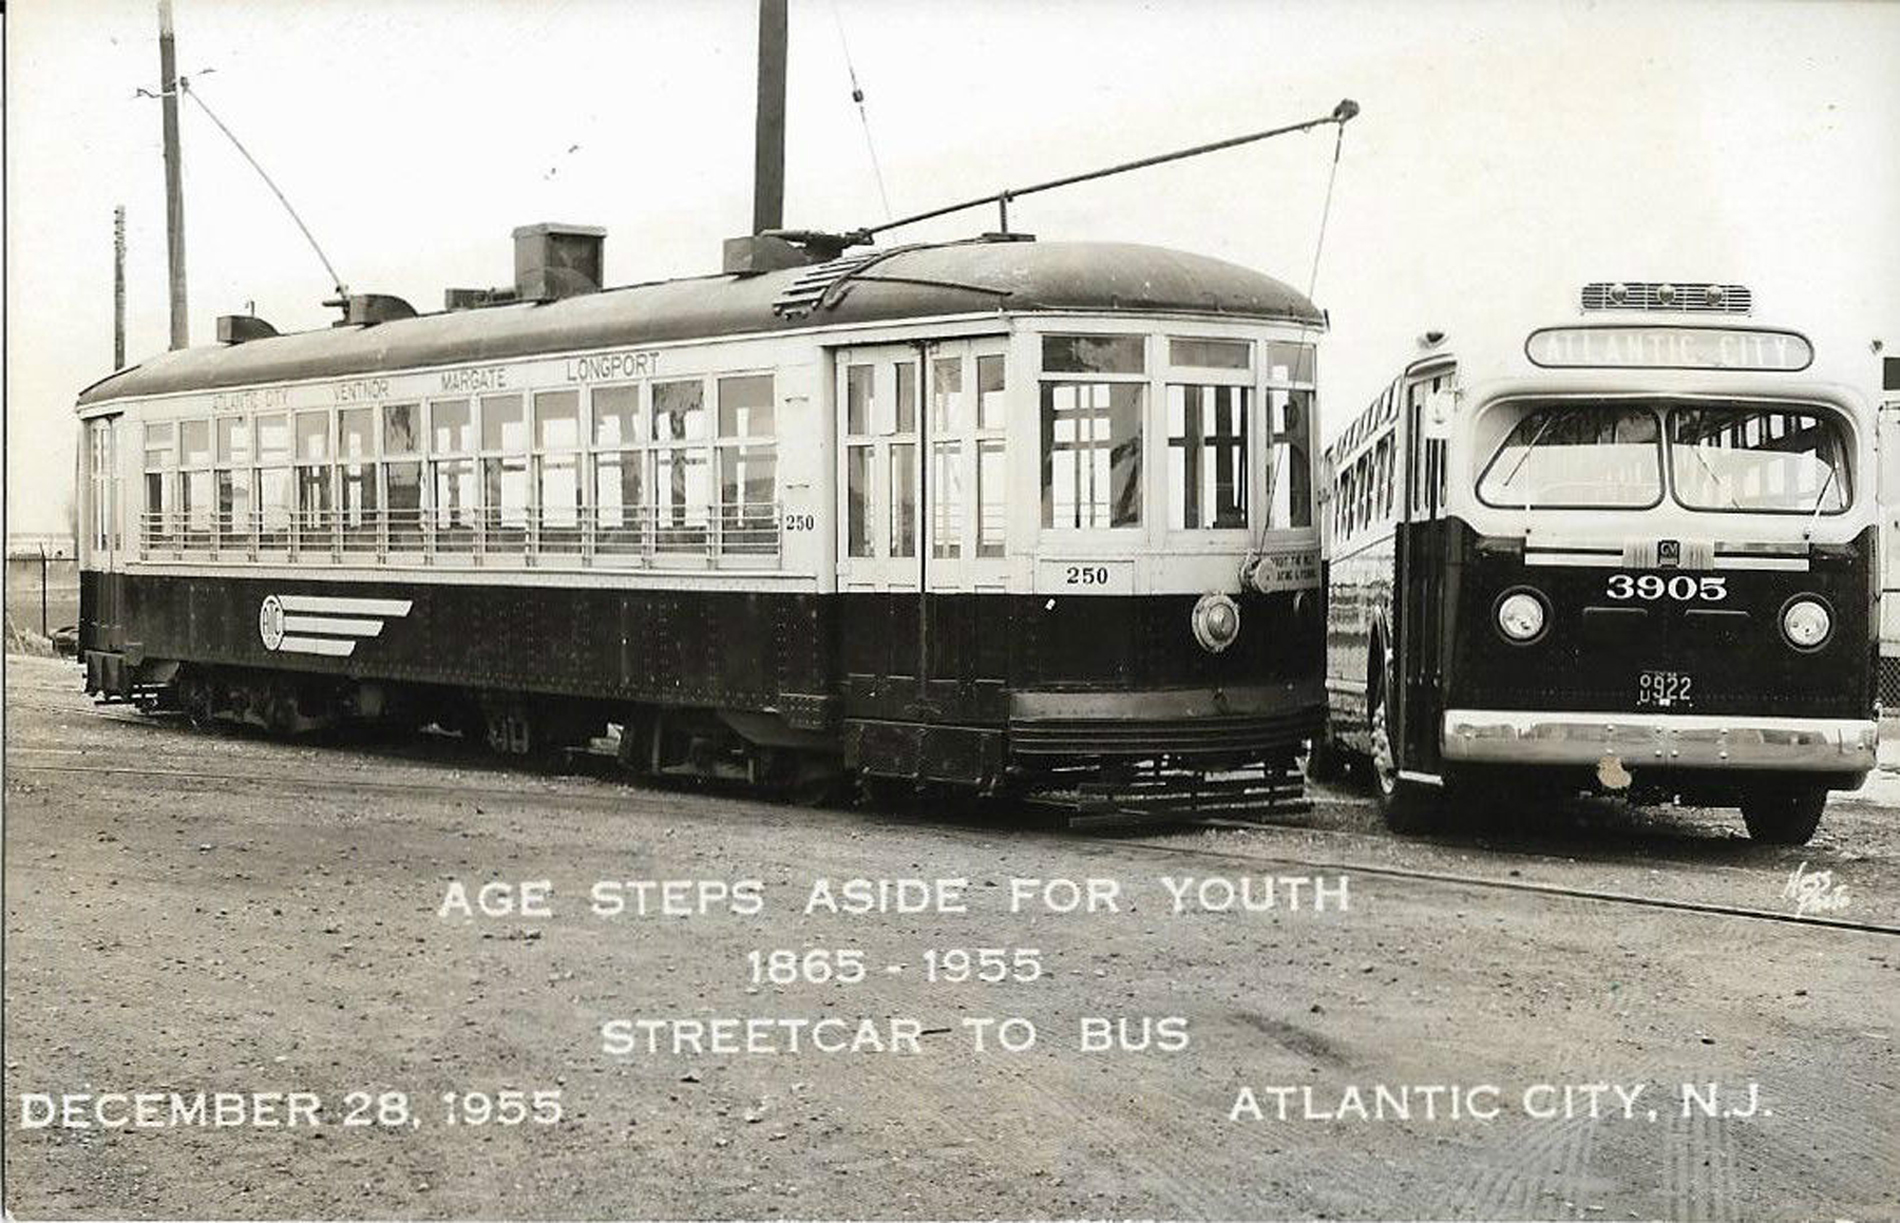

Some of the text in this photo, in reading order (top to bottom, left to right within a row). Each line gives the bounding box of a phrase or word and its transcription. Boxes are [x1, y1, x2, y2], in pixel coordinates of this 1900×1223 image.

[1546, 335, 1789, 367] ATLANTIC CITY
[440, 367, 507, 392] MARGATE
[565, 351, 661, 383] LONGPORT
[333, 380, 391, 403] VENTNOR
[785, 514, 815, 532] 250
[1066, 566, 1109, 585] 250
[1606, 574, 1728, 601] 3905
[1652, 675, 1692, 700] 922
